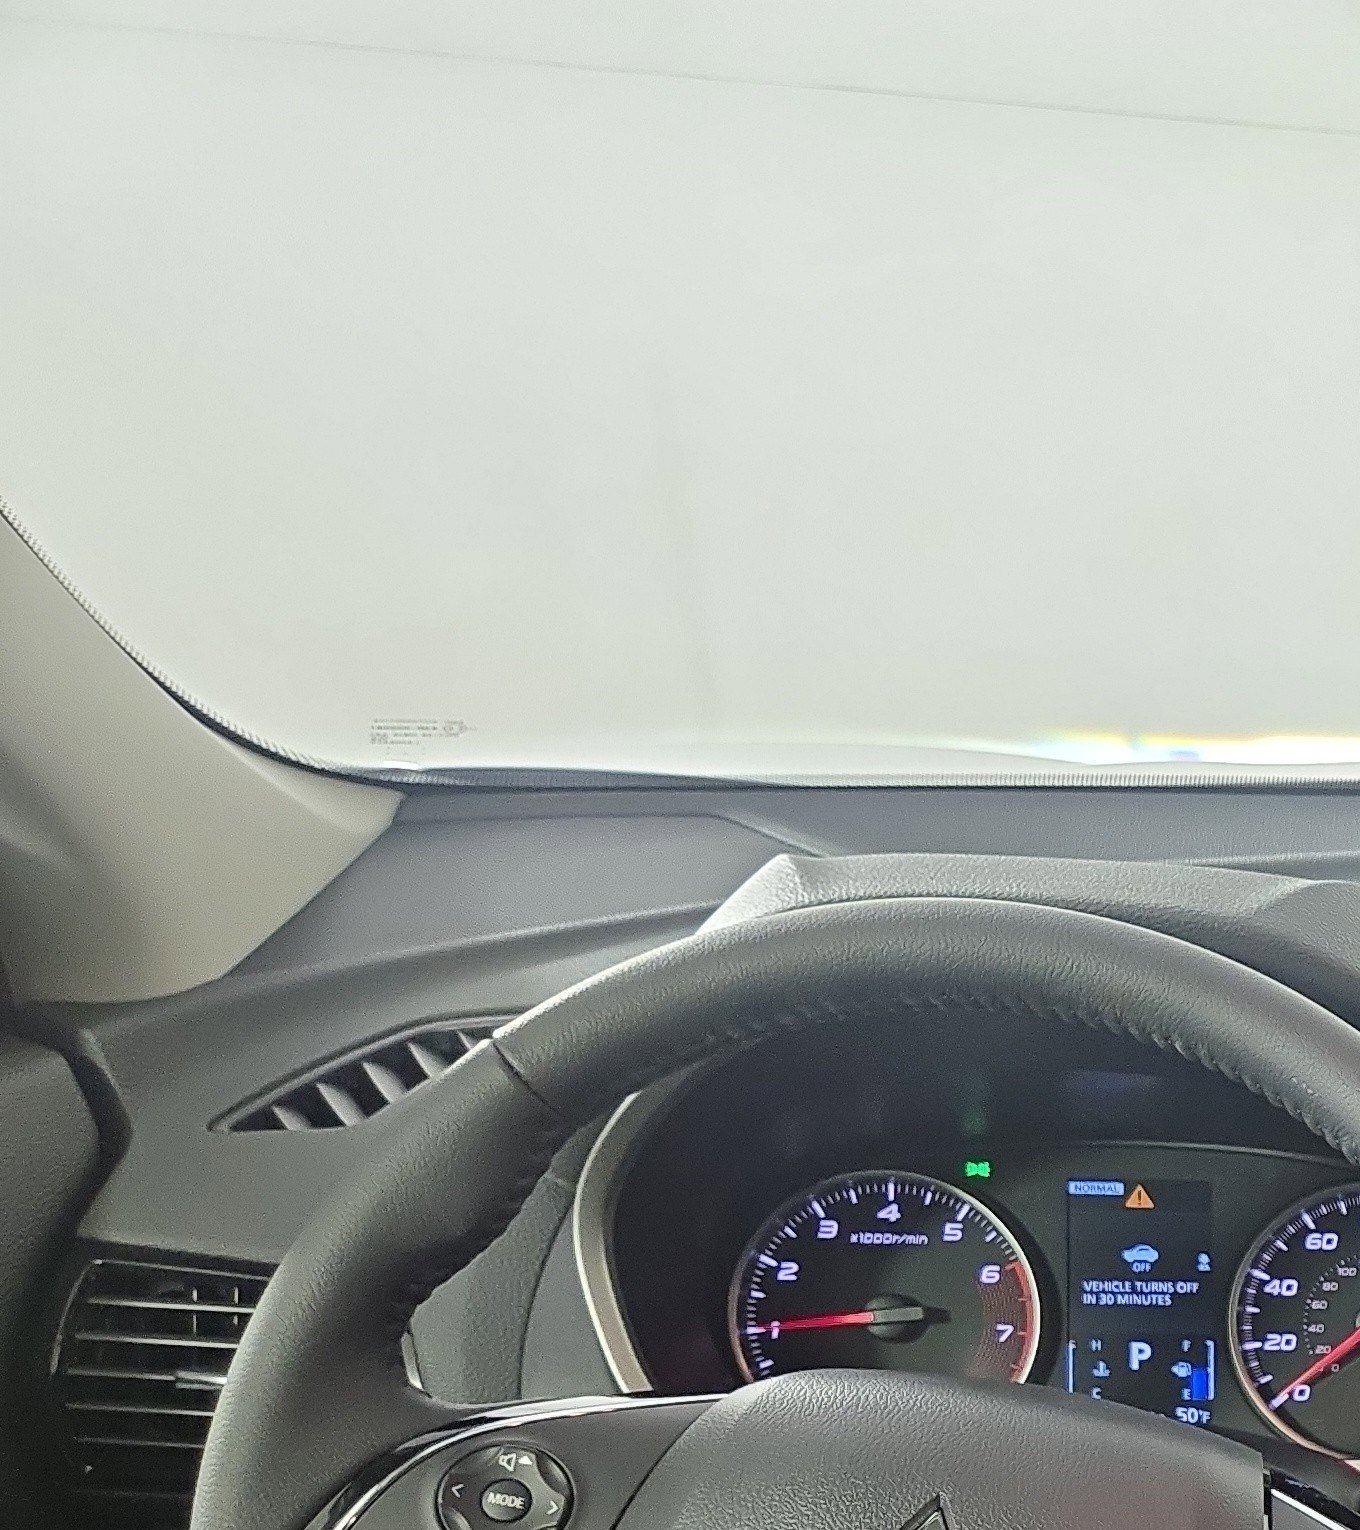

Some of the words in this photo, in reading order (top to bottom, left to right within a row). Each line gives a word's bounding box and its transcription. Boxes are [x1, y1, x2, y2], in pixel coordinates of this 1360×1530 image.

[1075, 1184, 1119, 1193] NORMAL
[877, 1203, 901, 1222] 4
[817, 1220, 838, 1239] 3
[943, 1223, 963, 1242] 5
[1305, 1233, 1338, 1250] 60
[777, 1262, 799, 1281] 2
[979, 1265, 1000, 1284] 6
[1133, 1263, 1151, 1272] OFF
[1337, 1267, 1357, 1277] 100
[1083, 1281, 1131, 1292] VEHICLE
[1135, 1282, 1174, 1293] TURNS
[1176, 1283, 1199, 1293] OFF
[1263, 1278, 1298, 1296] 40
[1322, 1282, 1339, 1292] 80
[1082, 1294, 1093, 1305] IN
[1100, 1294, 1114, 1305] 30
[1118, 1295, 1172, 1306] MINUTES
[995, 1323, 1014, 1343] 7
[1307, 1324, 1325, 1333] 40
[1091, 1339, 1101, 1351] H
[1182, 1339, 1191, 1351] F
[1263, 1333, 1297, 1351] 20
[1129, 1341, 1152, 1371] P
[1091, 1388, 1101, 1399] C
[1182, 1388, 1191, 1400] E
[1292, 1385, 1311, 1401] 0
[486, 1490, 526, 1511] MODE
